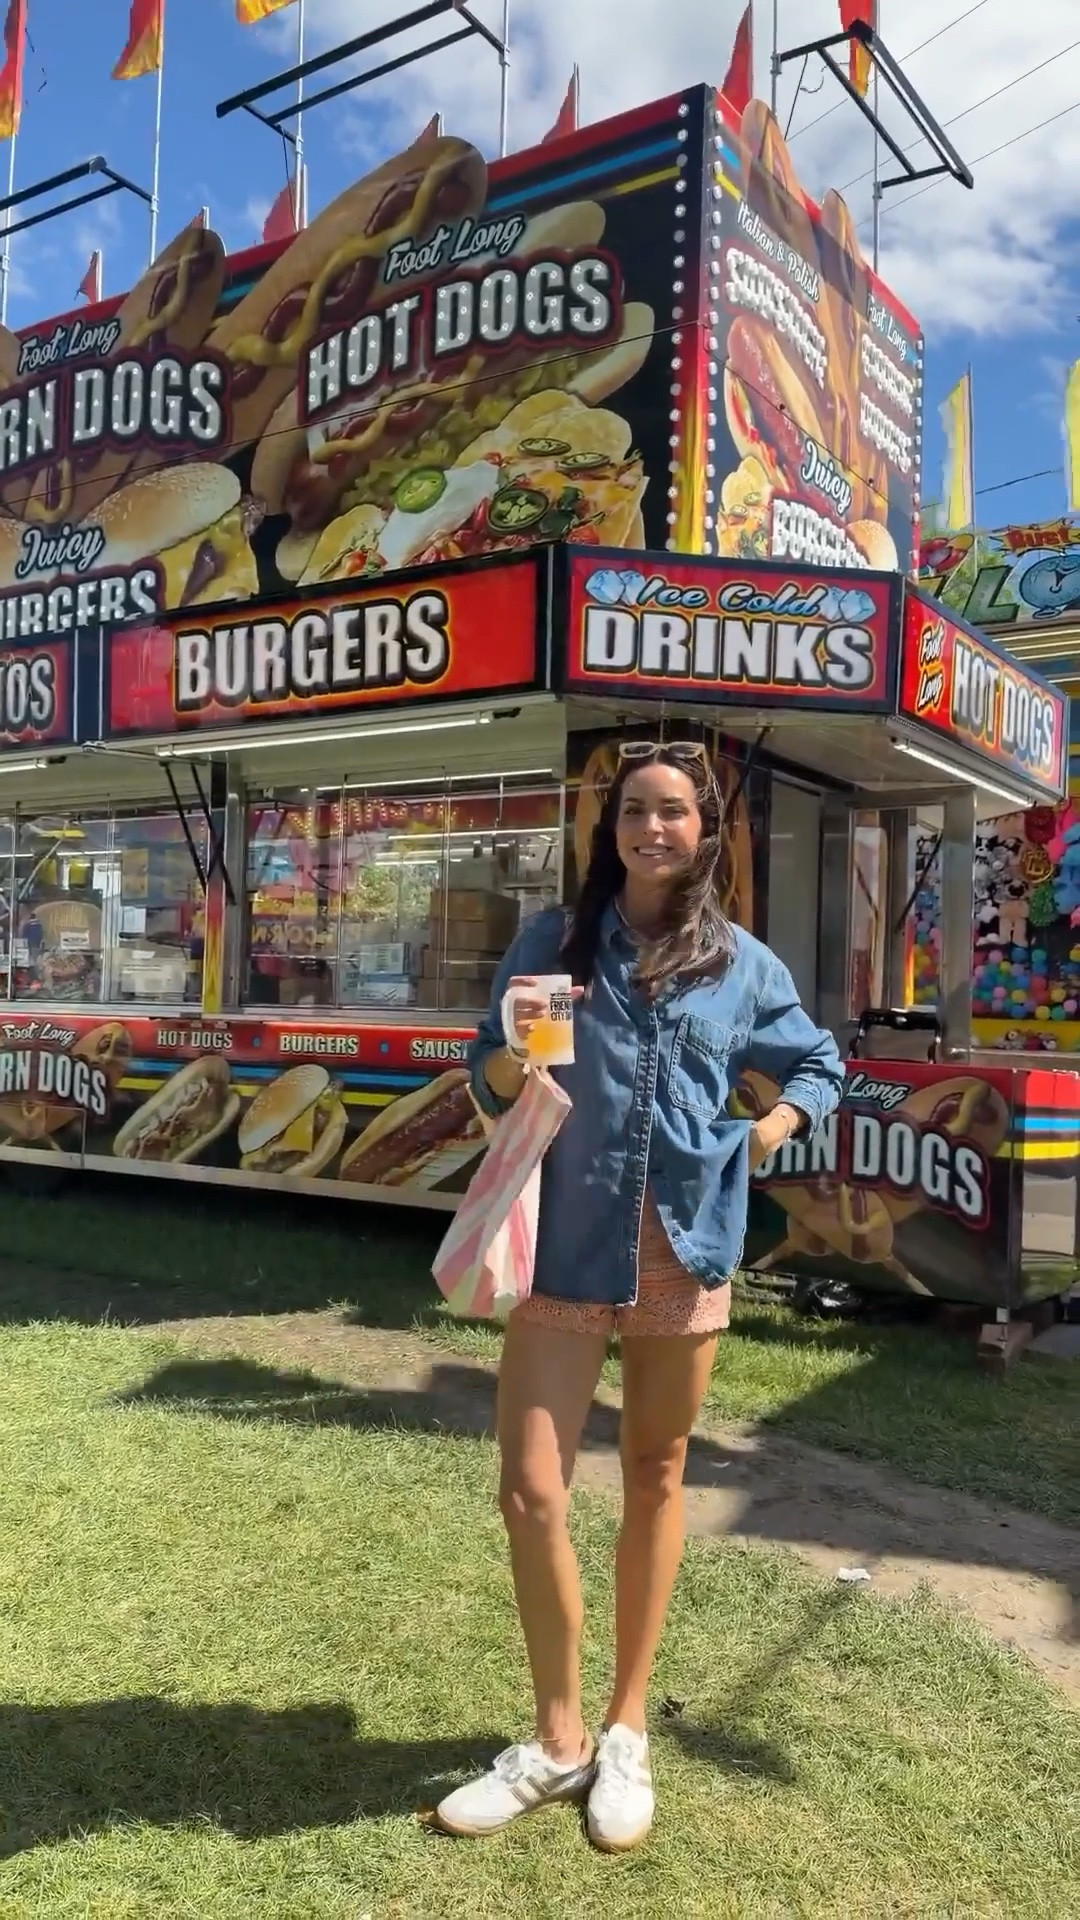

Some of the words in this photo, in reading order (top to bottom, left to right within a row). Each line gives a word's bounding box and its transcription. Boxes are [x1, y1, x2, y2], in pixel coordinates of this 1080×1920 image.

[386, 228, 450, 281] Foot
[450, 214, 524, 259] Long
[737, 201, 775, 256] Italian
[777, 242, 786, 262] &
[788, 252, 820, 302] Polish
[19, 325, 66, 372] Foot
[66, 318, 120, 357] Long
[308, 295, 420, 414] HOT
[435, 258, 610, 355] DOGS
[887, 315, 907, 362] Long
[73, 358, 222, 442] DOGS
[802, 440, 852, 514] Juicy
[18, 525, 104, 576] Juicy
[637, 577, 707, 607] Ice
[721, 583, 827, 616] Cold
[177, 594, 448, 704] BURGERS
[586, 608, 873, 687] DRINKS
[920, 624, 944, 664] Foot
[0, 659, 51, 724] OS
[918, 671, 943, 708] Long
[955, 643, 1000, 734] HOT
[1002, 677, 1053, 767] DOGS
[2, 1021, 39, 1040] Foot
[39, 1022, 75, 1046] Long
[157, 1030, 187, 1047] HOT
[191, 1031, 233, 1050] DOGS
[280, 1034, 359, 1055] BURGERS
[38, 1052, 106, 1116] DOGS
[848, 1073, 909, 1110] Long
[852, 1114, 984, 1218] DOGS
